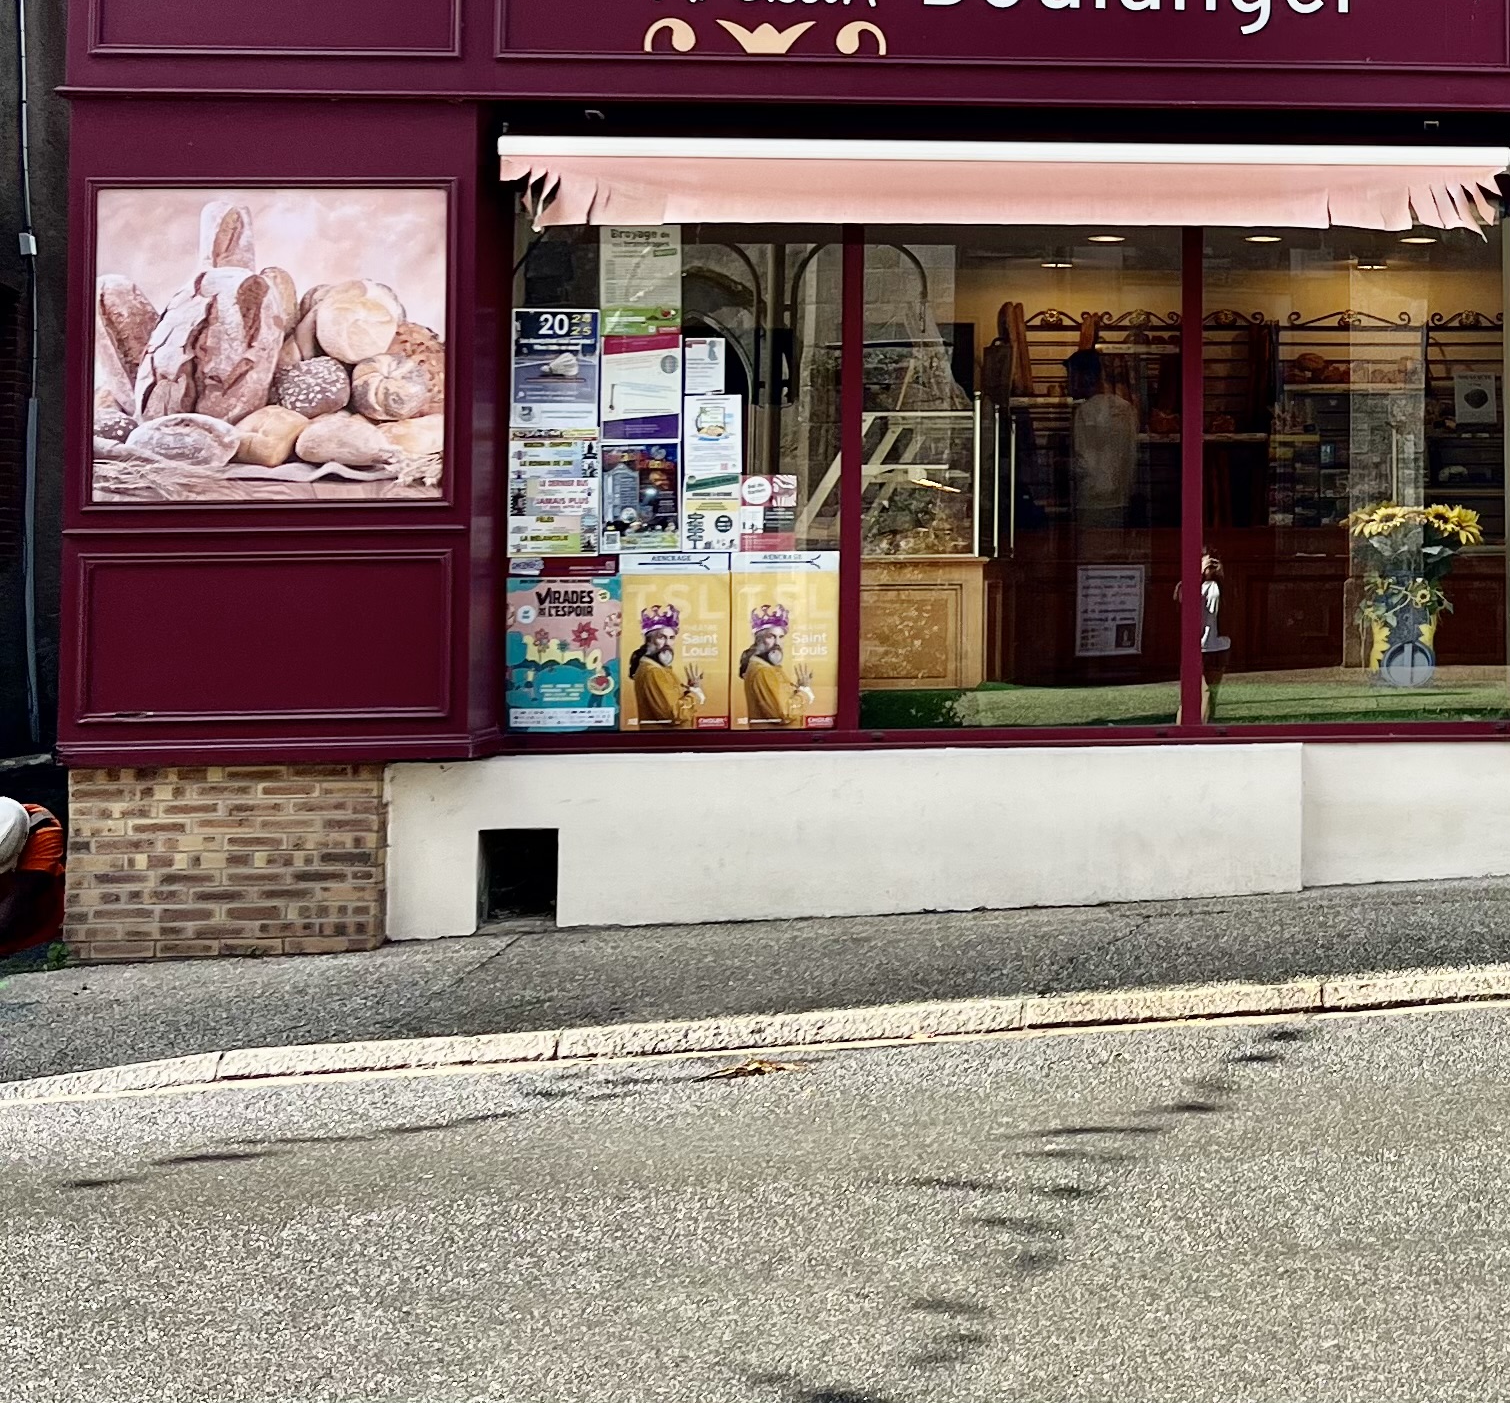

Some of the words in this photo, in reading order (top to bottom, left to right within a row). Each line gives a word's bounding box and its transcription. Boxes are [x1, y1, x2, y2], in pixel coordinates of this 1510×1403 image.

[538, 313, 570, 335] 20
[535, 587, 595, 606] VIRADES
[682, 632, 718, 645] Saint
[792, 632, 828, 644] Saint
[682, 645, 719, 657] Louis
[792, 644, 828, 656] Louis
